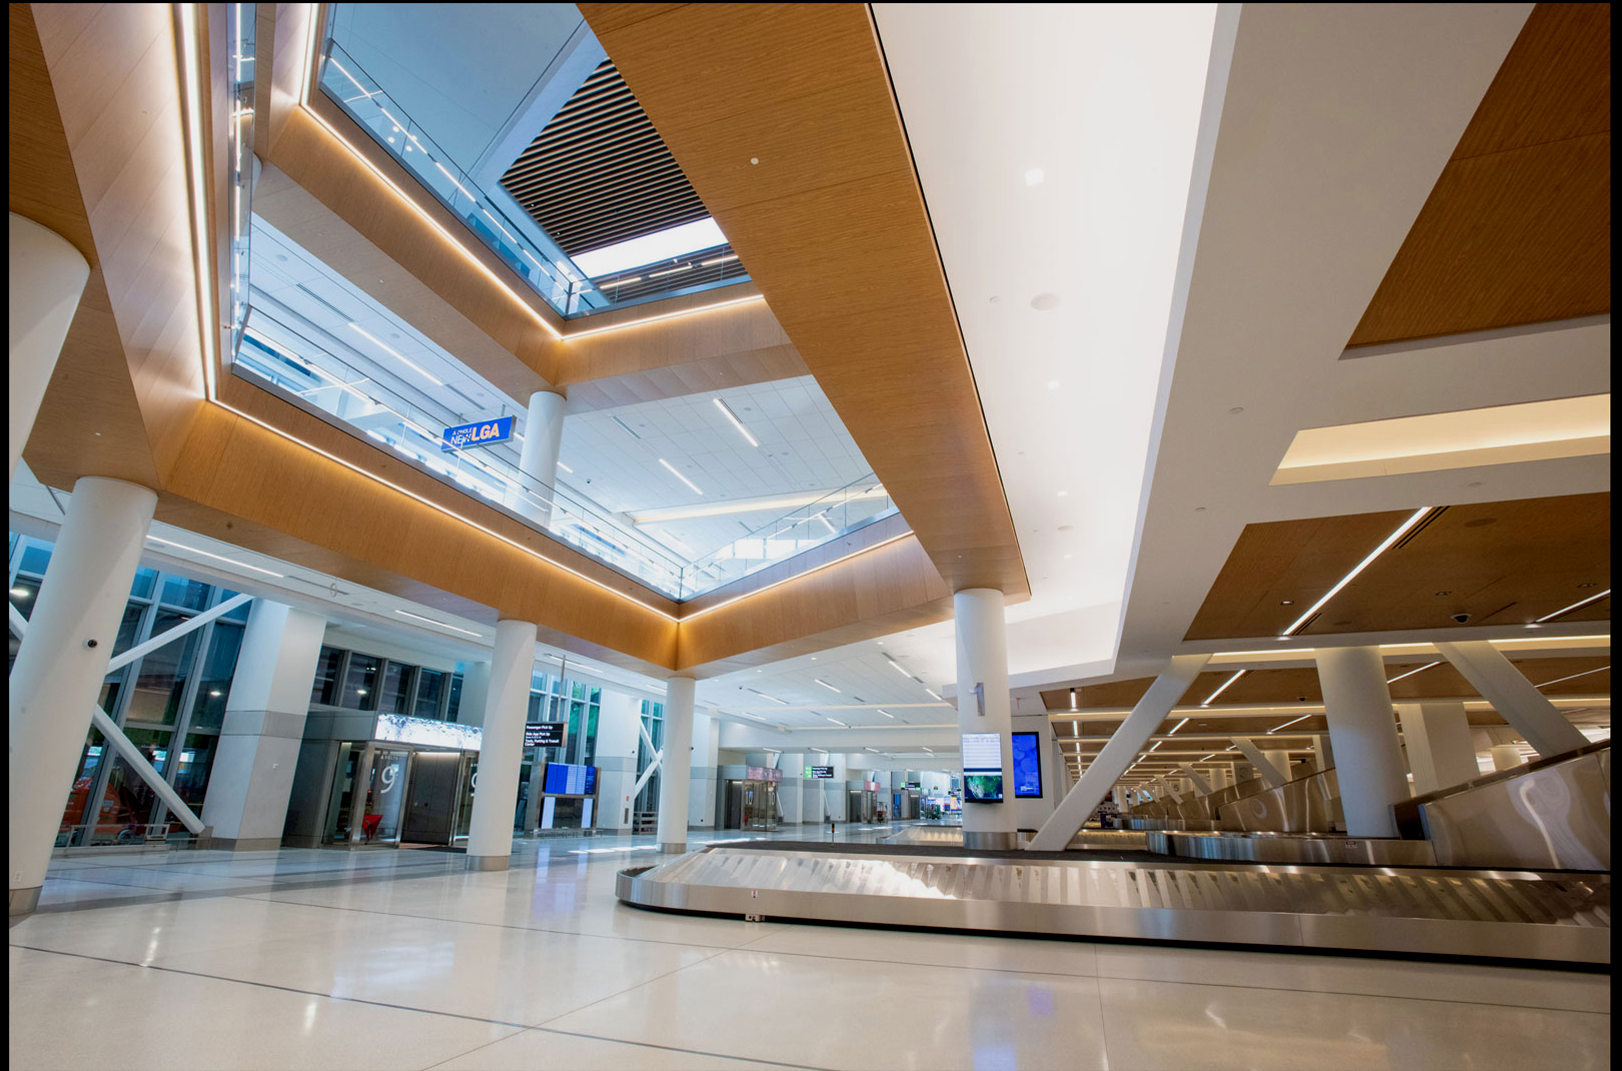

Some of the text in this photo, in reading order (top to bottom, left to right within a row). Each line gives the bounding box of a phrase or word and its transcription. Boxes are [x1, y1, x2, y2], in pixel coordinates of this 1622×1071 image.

[471, 423, 500, 441] LGA
[969, 682, 985, 716] 1
[380, 766, 396, 794] 9
[1173, 784, 1180, 793] 5
